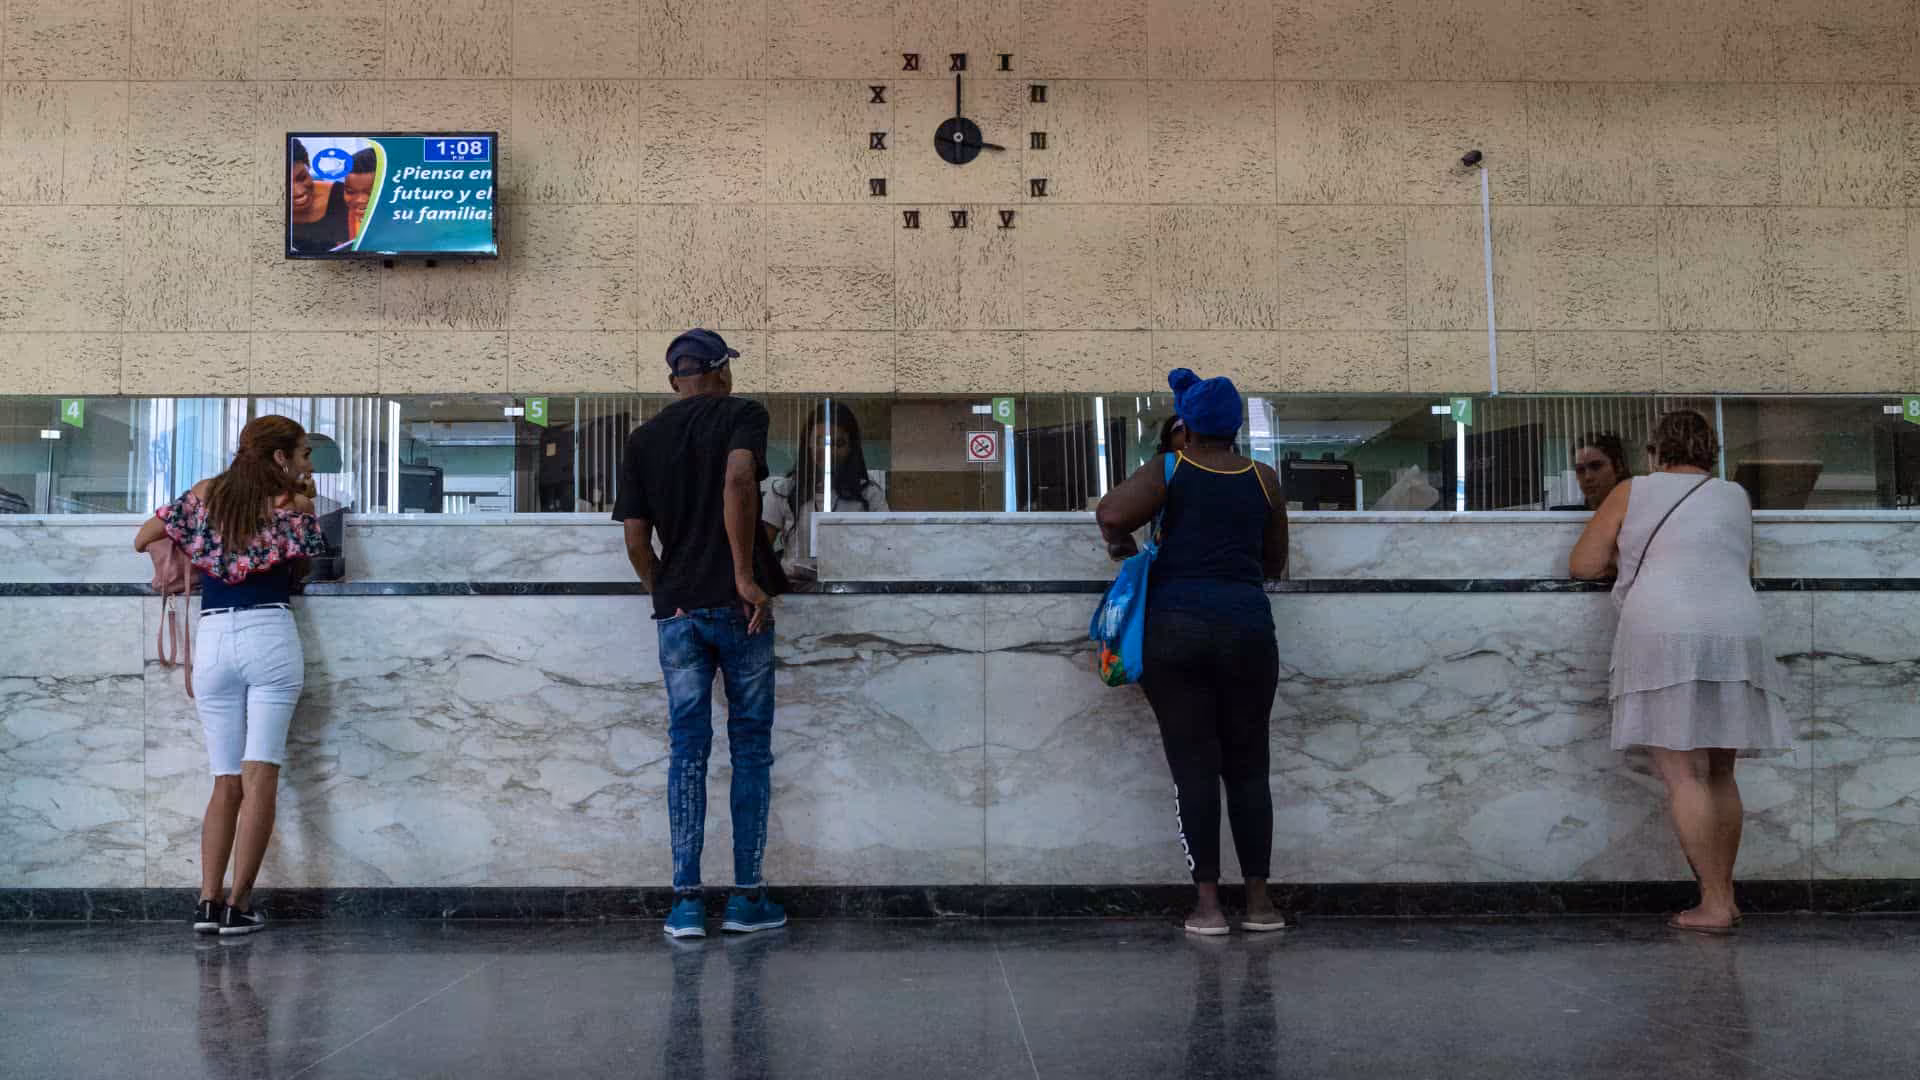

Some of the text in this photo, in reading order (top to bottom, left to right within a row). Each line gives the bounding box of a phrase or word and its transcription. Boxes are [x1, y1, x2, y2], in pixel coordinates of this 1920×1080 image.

[902, 53, 919, 71] XI
[996, 53, 1014, 71] I
[869, 86, 888, 103] X
[1030, 85, 1048, 103] II
[436, 141, 482, 155] 1:08
[869, 132, 888, 150] IX
[392, 166, 492, 183] ¿Piensa en
[388, 185, 493, 204] futuro y el
[1030, 178, 1048, 197] IV
[392, 209, 414, 220] su
[903, 210, 920, 229] VII
[950, 210, 968, 229] VI
[997, 210, 1016, 229] V
[67, 400, 80, 418] 4
[531, 400, 543, 418] 5
[998, 399, 1011, 417] 6
[1456, 399, 1467, 417] 7
[1909, 399, 1920, 417] 8
